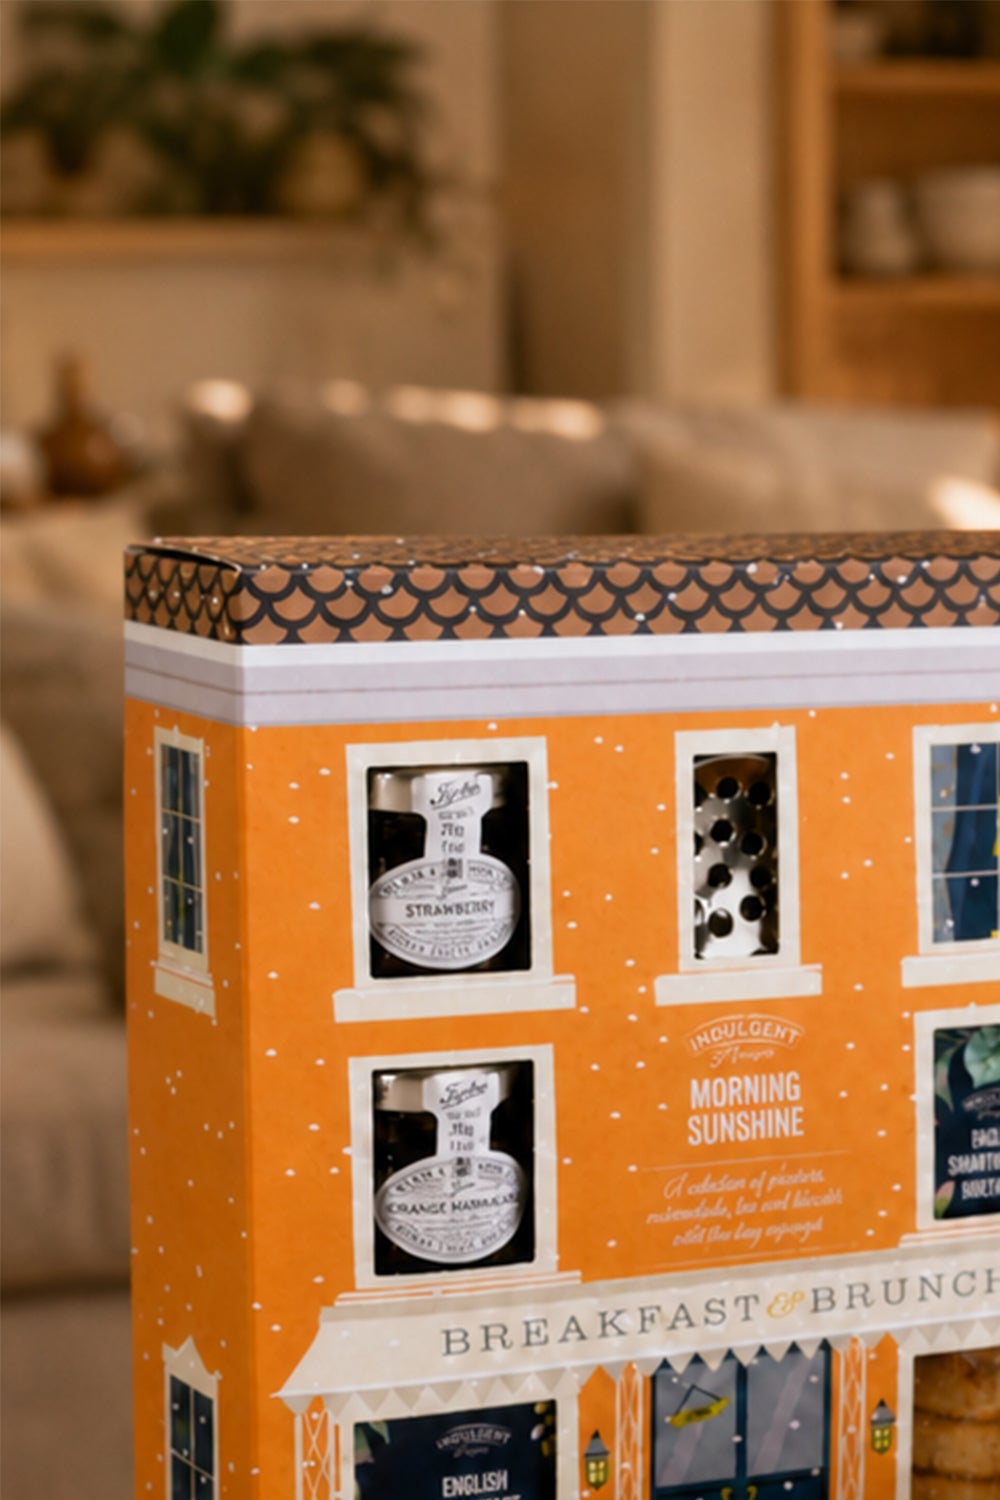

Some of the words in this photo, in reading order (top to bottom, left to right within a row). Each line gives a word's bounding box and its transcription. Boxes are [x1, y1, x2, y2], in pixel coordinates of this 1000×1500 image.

[689, 1018, 801, 1052] INDULGENT
[690, 1071, 801, 1111] MORNING
[687, 1106, 805, 1147] SUNSHINE
[441, 1293, 760, 1357] BREAKFAST
[766, 1290, 806, 1320] &
[442, 1470, 509, 1498] ENGLISH
